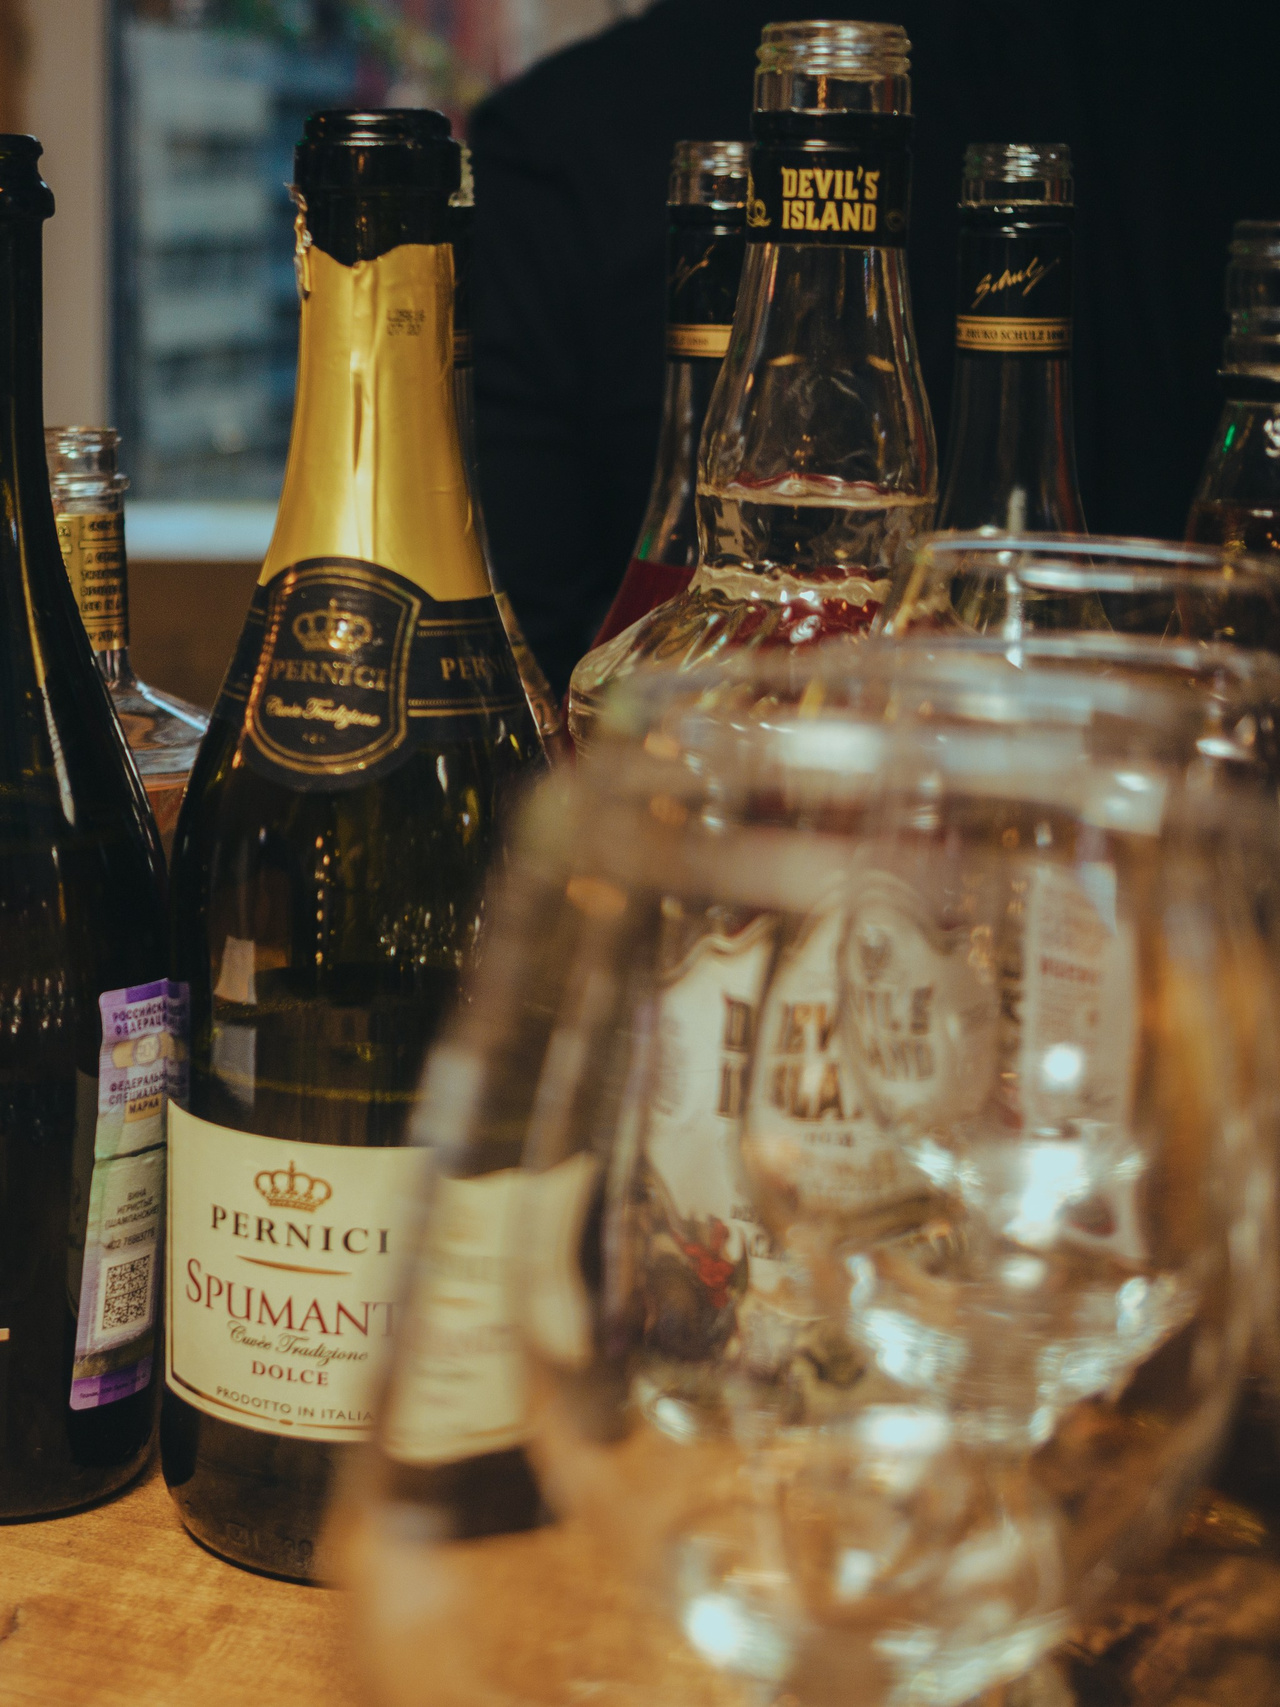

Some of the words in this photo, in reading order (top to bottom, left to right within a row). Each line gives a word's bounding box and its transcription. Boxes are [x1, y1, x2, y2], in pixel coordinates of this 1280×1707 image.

[781, 165, 880, 200] DEVIL'S
[782, 200, 877, 232] ISLAND
[210, 1203, 391, 1254] PERNICI
[250, 1359, 330, 1386] DOLCE
[215, 1385, 293, 1415] PRODOTTO
[297, 1406, 315, 1418] IN
